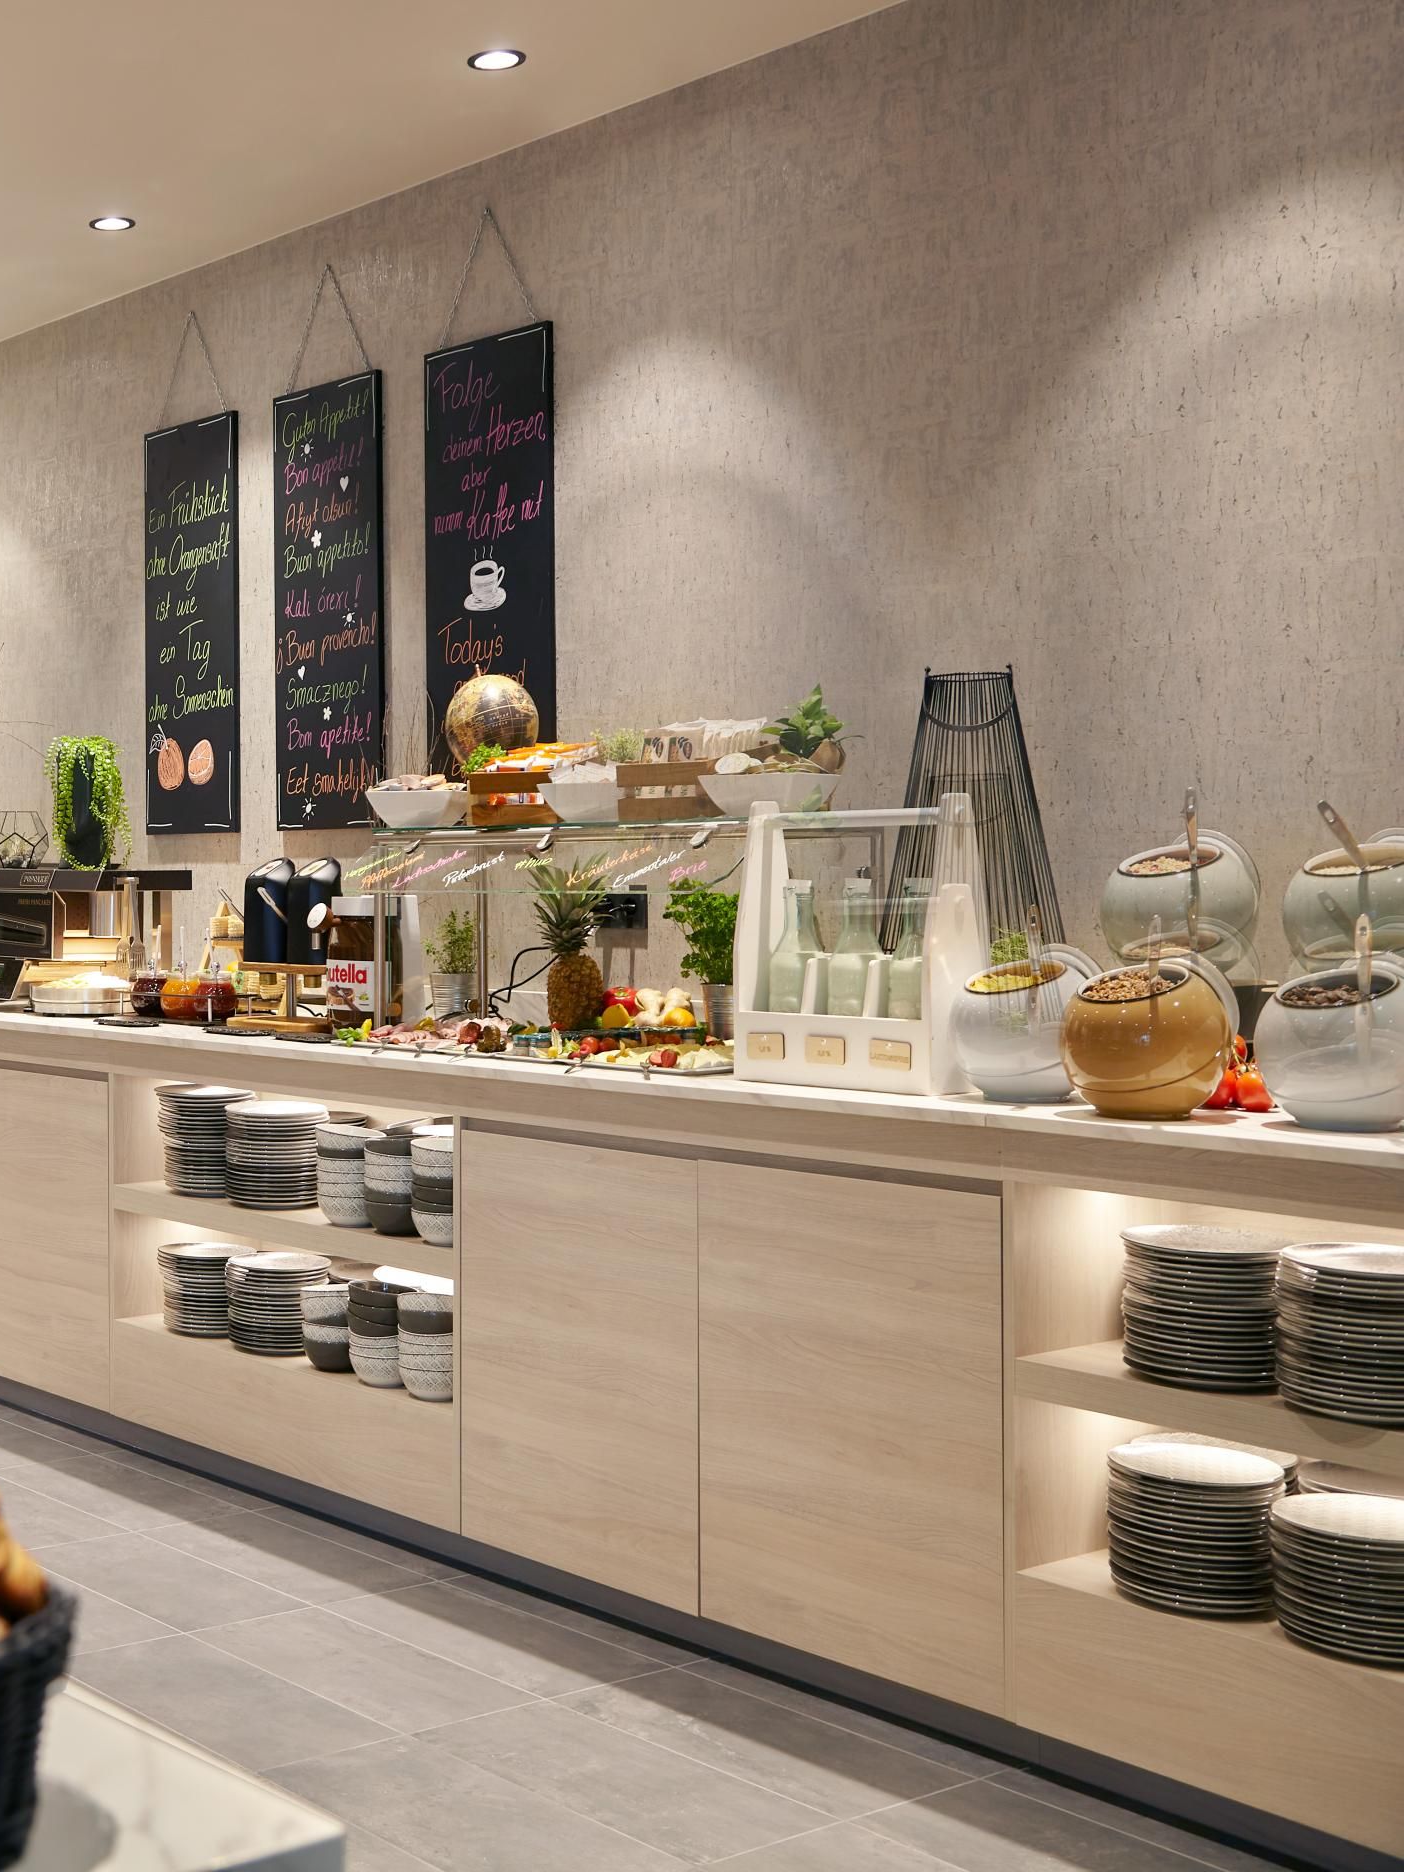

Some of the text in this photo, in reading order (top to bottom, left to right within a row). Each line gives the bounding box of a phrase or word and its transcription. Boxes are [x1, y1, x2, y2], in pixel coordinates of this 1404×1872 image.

[434, 360, 500, 432] Folge
[443, 433, 483, 463] deinem
[284, 462, 309, 495] Bon
[461, 462, 492, 492] aber
[148, 473, 230, 534] Ein Frühstück
[434, 479, 544, 541] nimm Kaffee mit
[147, 521, 231, 591] ohne Orangensaft
[284, 544, 313, 579] Buon
[156, 591, 198, 621] ist wie
[284, 588, 311, 619] Kali
[159, 619, 211, 681] ein Tag
[438, 617, 504, 674] Today's
[148, 674, 234, 723] ohne Sonnenschein
[287, 717, 312, 751] Bom
[286, 763, 309, 795] Eet
[669, 860, 709, 882] Brie
[326, 963, 367, 984] utella
